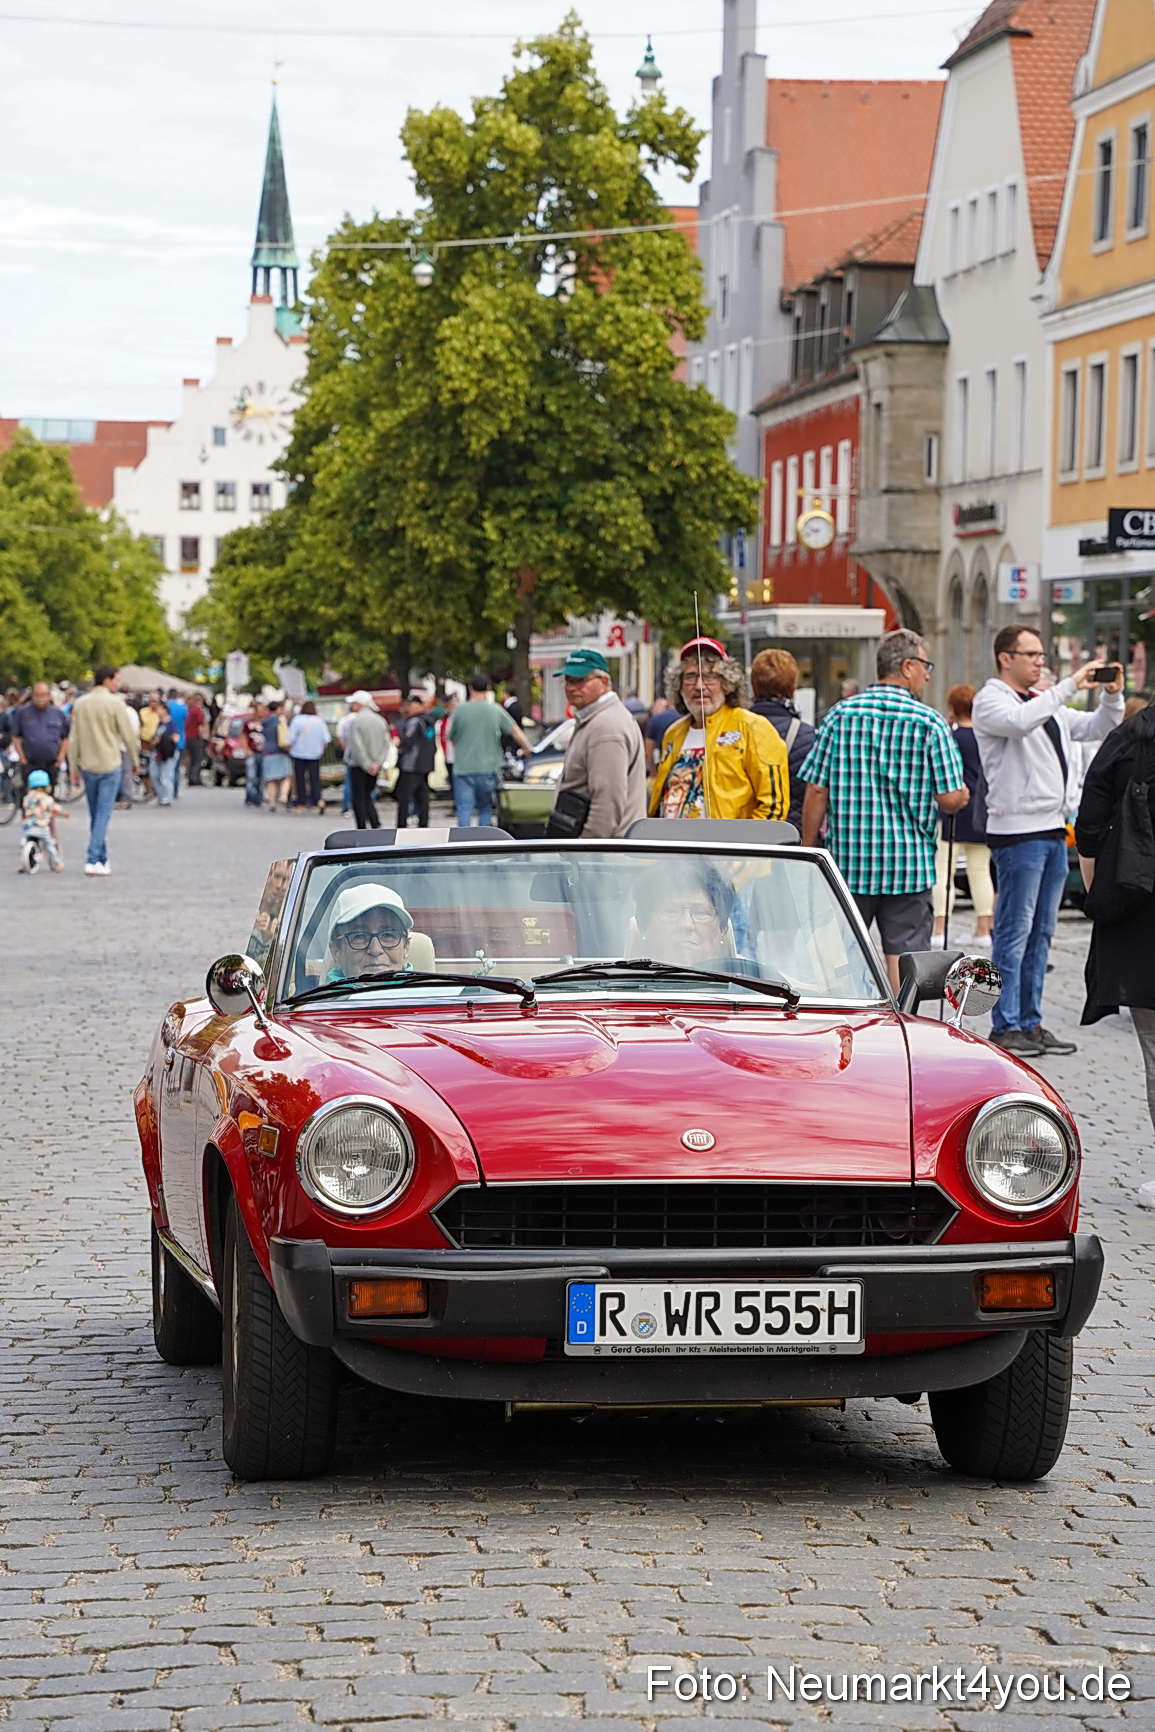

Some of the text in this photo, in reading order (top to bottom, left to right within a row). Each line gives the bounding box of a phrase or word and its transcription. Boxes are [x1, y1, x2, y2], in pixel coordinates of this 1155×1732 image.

[689, 1133, 708, 1144] FIAT
[599, 1291, 627, 1336] R
[663, 1291, 722, 1336] WR
[734, 1290, 856, 1336] 555H
[577, 1321, 587, 1335] D
[610, 1345, 632, 1354] Gerd
[634, 1345, 671, 1354] Gesslein
[675, 1346, 687, 1354] Ihr
[689, 1345, 702, 1354] Kfz
[709, 1345, 764, 1353] Meisterbetrieb
[766, 1345, 774, 1353] in
[776, 1345, 820, 1355] Marktgraitz
